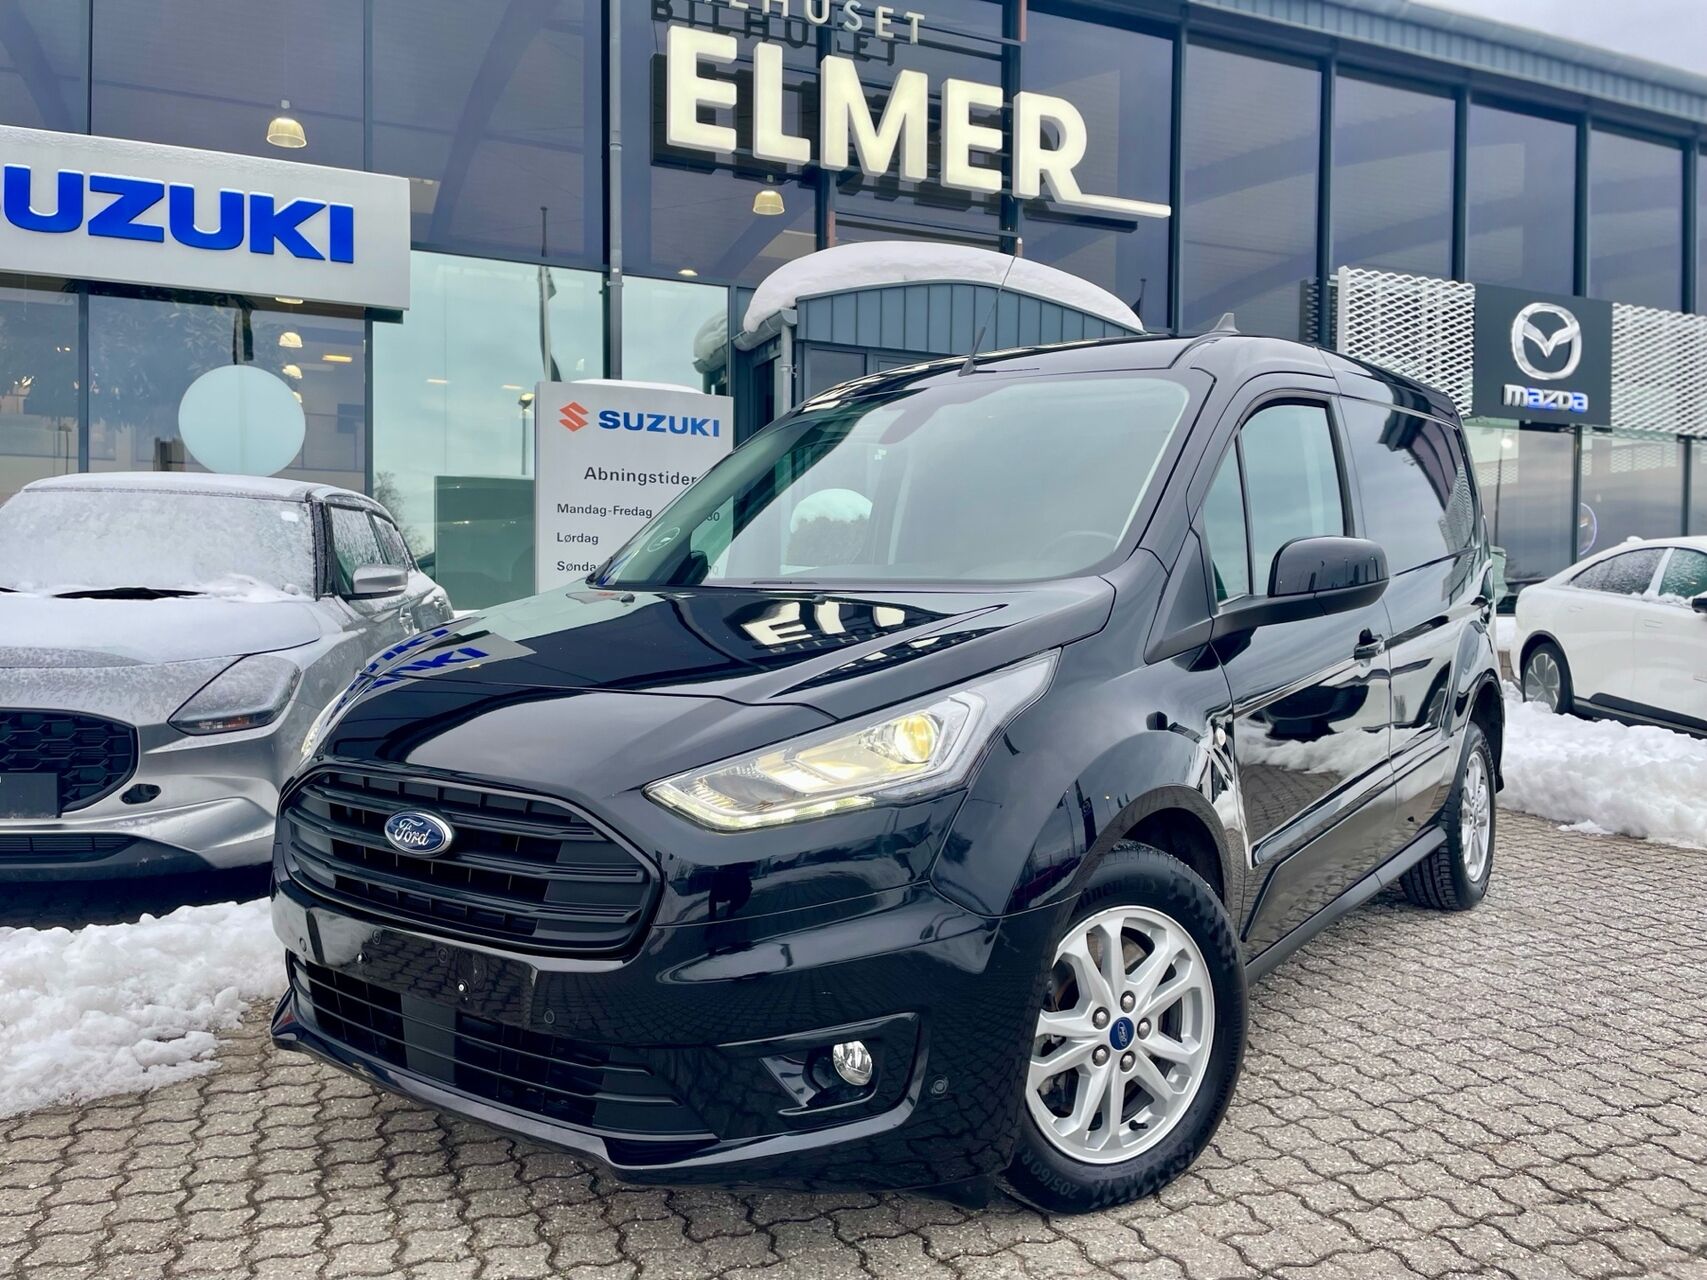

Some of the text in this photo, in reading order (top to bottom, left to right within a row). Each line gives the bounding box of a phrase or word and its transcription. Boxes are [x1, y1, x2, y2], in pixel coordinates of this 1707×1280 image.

[666, 24, 1171, 218] ELMER
[0, 163, 354, 265] UZUKI
[1502, 383, 1589, 413] mazda
[598, 410, 720, 438] SUZUKI
[556, 503, 653, 519] Mandag-Fredag
[556, 532, 599, 546] Lørdag
[556, 561, 600, 572] Sønda
[394, 818, 431, 846] Ford
